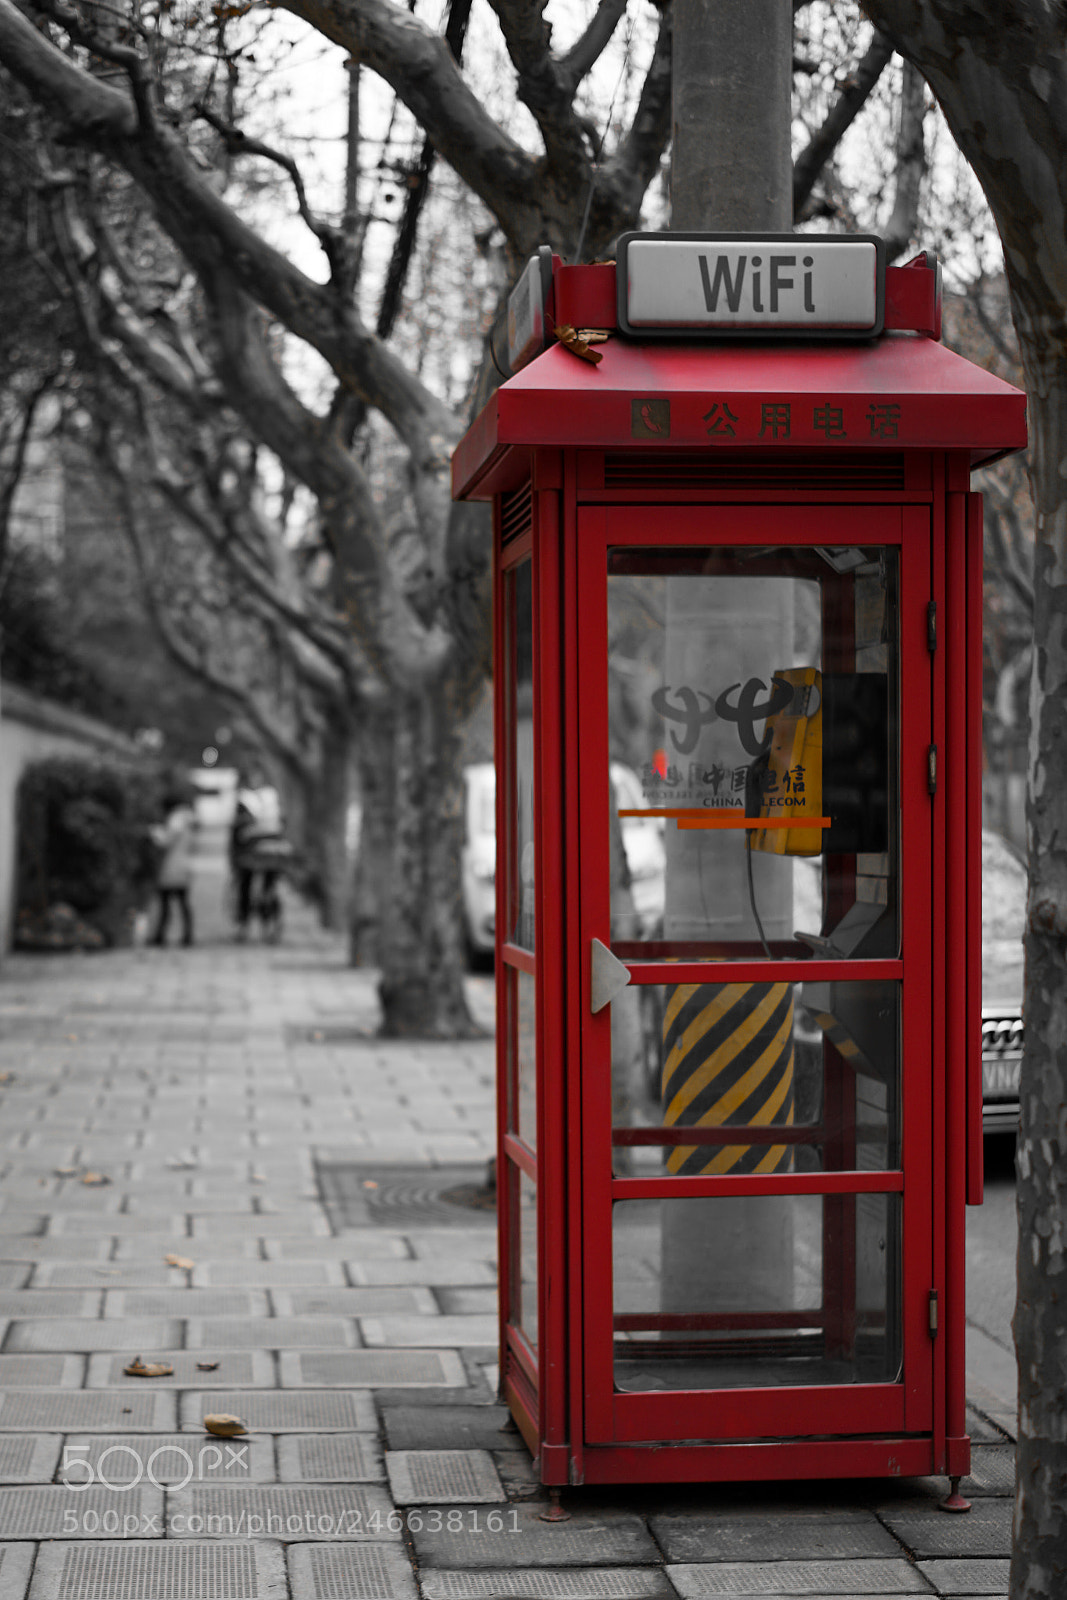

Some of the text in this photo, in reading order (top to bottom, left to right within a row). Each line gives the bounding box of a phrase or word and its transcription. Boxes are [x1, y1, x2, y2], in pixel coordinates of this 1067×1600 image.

[698, 255, 816, 313] WiFi
[702, 402, 901, 440] 公用电话
[702, 763, 806, 796] 中国电信
[703, 797, 806, 807] CHINA LECOM
